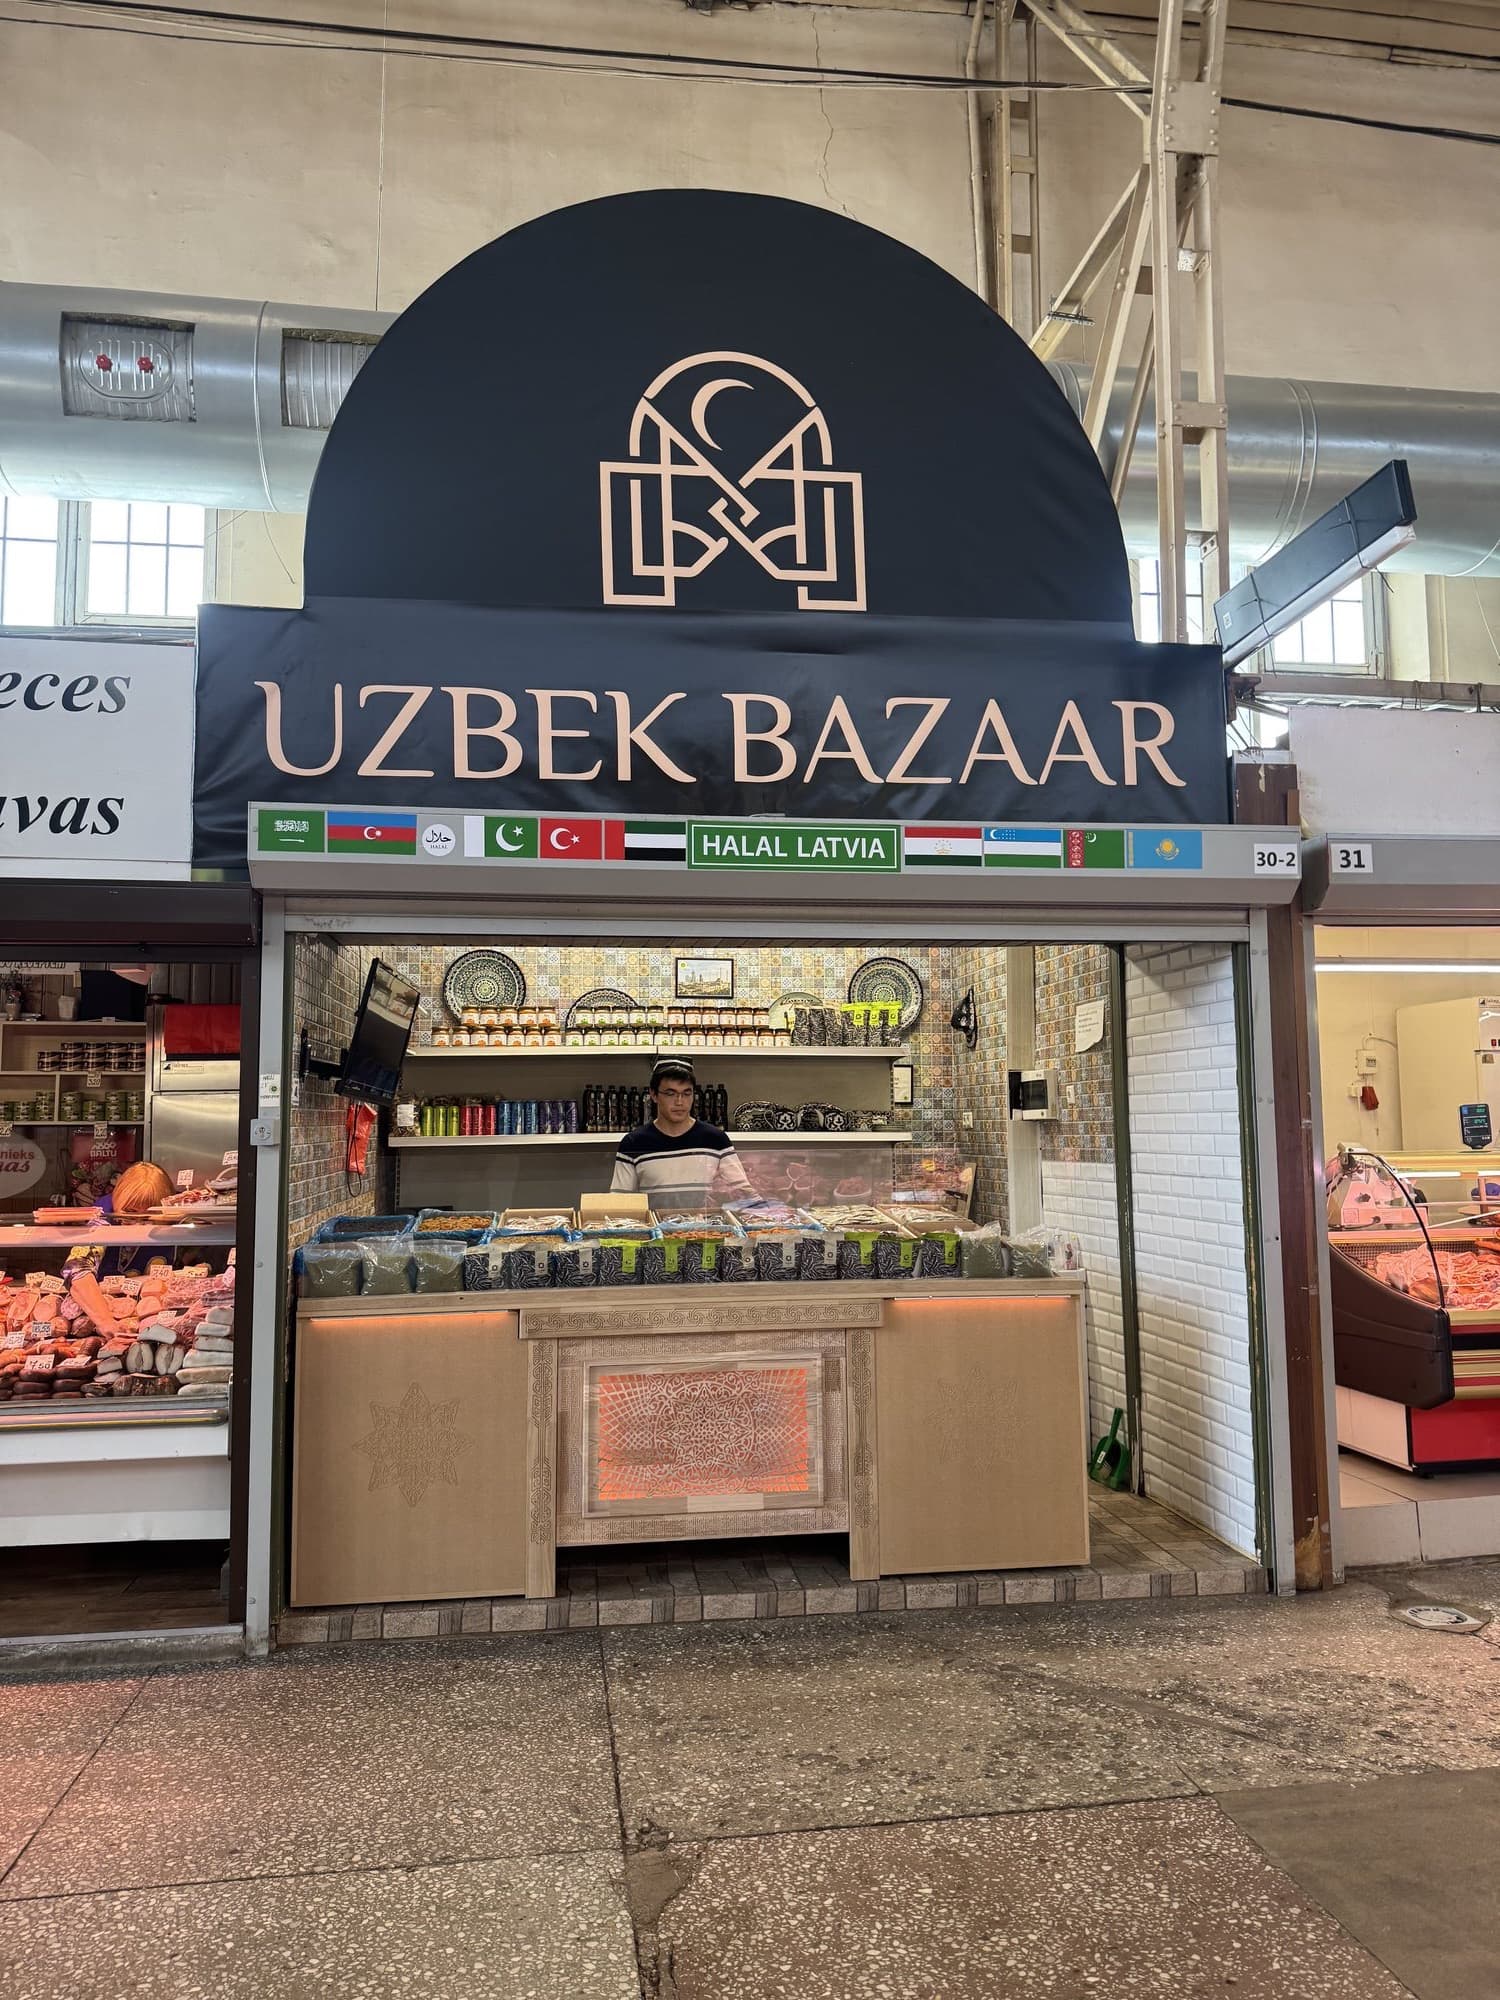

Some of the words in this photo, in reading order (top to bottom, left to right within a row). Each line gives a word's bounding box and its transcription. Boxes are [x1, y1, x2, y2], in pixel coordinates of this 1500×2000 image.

[253, 680, 697, 783] UZBEK
[721, 693, 1188, 787] BAZAAR
[0, 795, 125, 836] vas
[426, 829, 452, 843] حلال
[703, 834, 788, 857] HALAL
[797, 836, 886, 859] LATVIA
[1256, 851, 1296, 867] 30-2
[1339, 849, 1366, 869] 31
